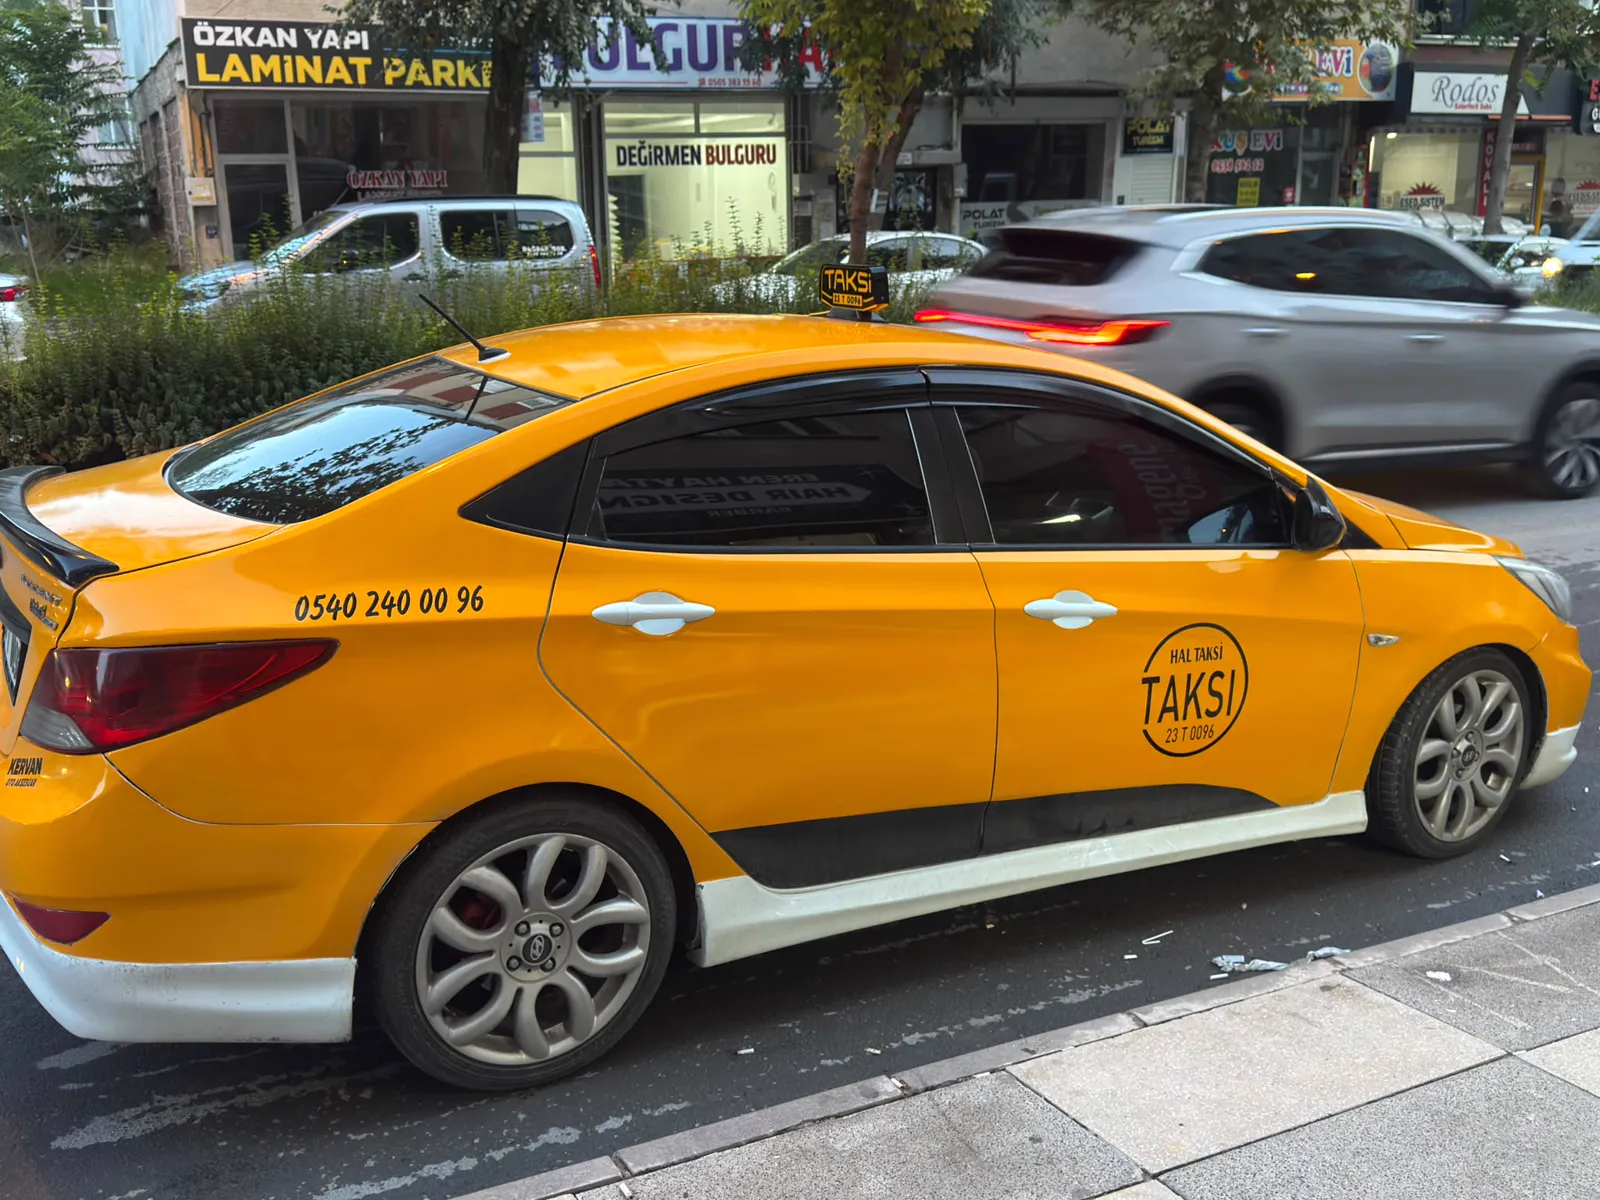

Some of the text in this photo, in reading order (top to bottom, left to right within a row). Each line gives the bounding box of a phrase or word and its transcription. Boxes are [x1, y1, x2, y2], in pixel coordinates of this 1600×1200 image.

[193, 21, 370, 50] ÖZKAN YAPI
[1432, 75, 1499, 108] Rodos
[705, 144, 777, 166] BULGURU
[408, 170, 449, 188] YAPI
[963, 208, 1005, 220] POLAT
[294, 585, 484, 622] 0540 240 00 96
[1170, 642, 1223, 664] HAL TAKSİ
[1141, 669, 1236, 725] TAKSI
[1165, 724, 1214, 743] 23 T 0096
[7, 757, 43, 776] KERVAN
